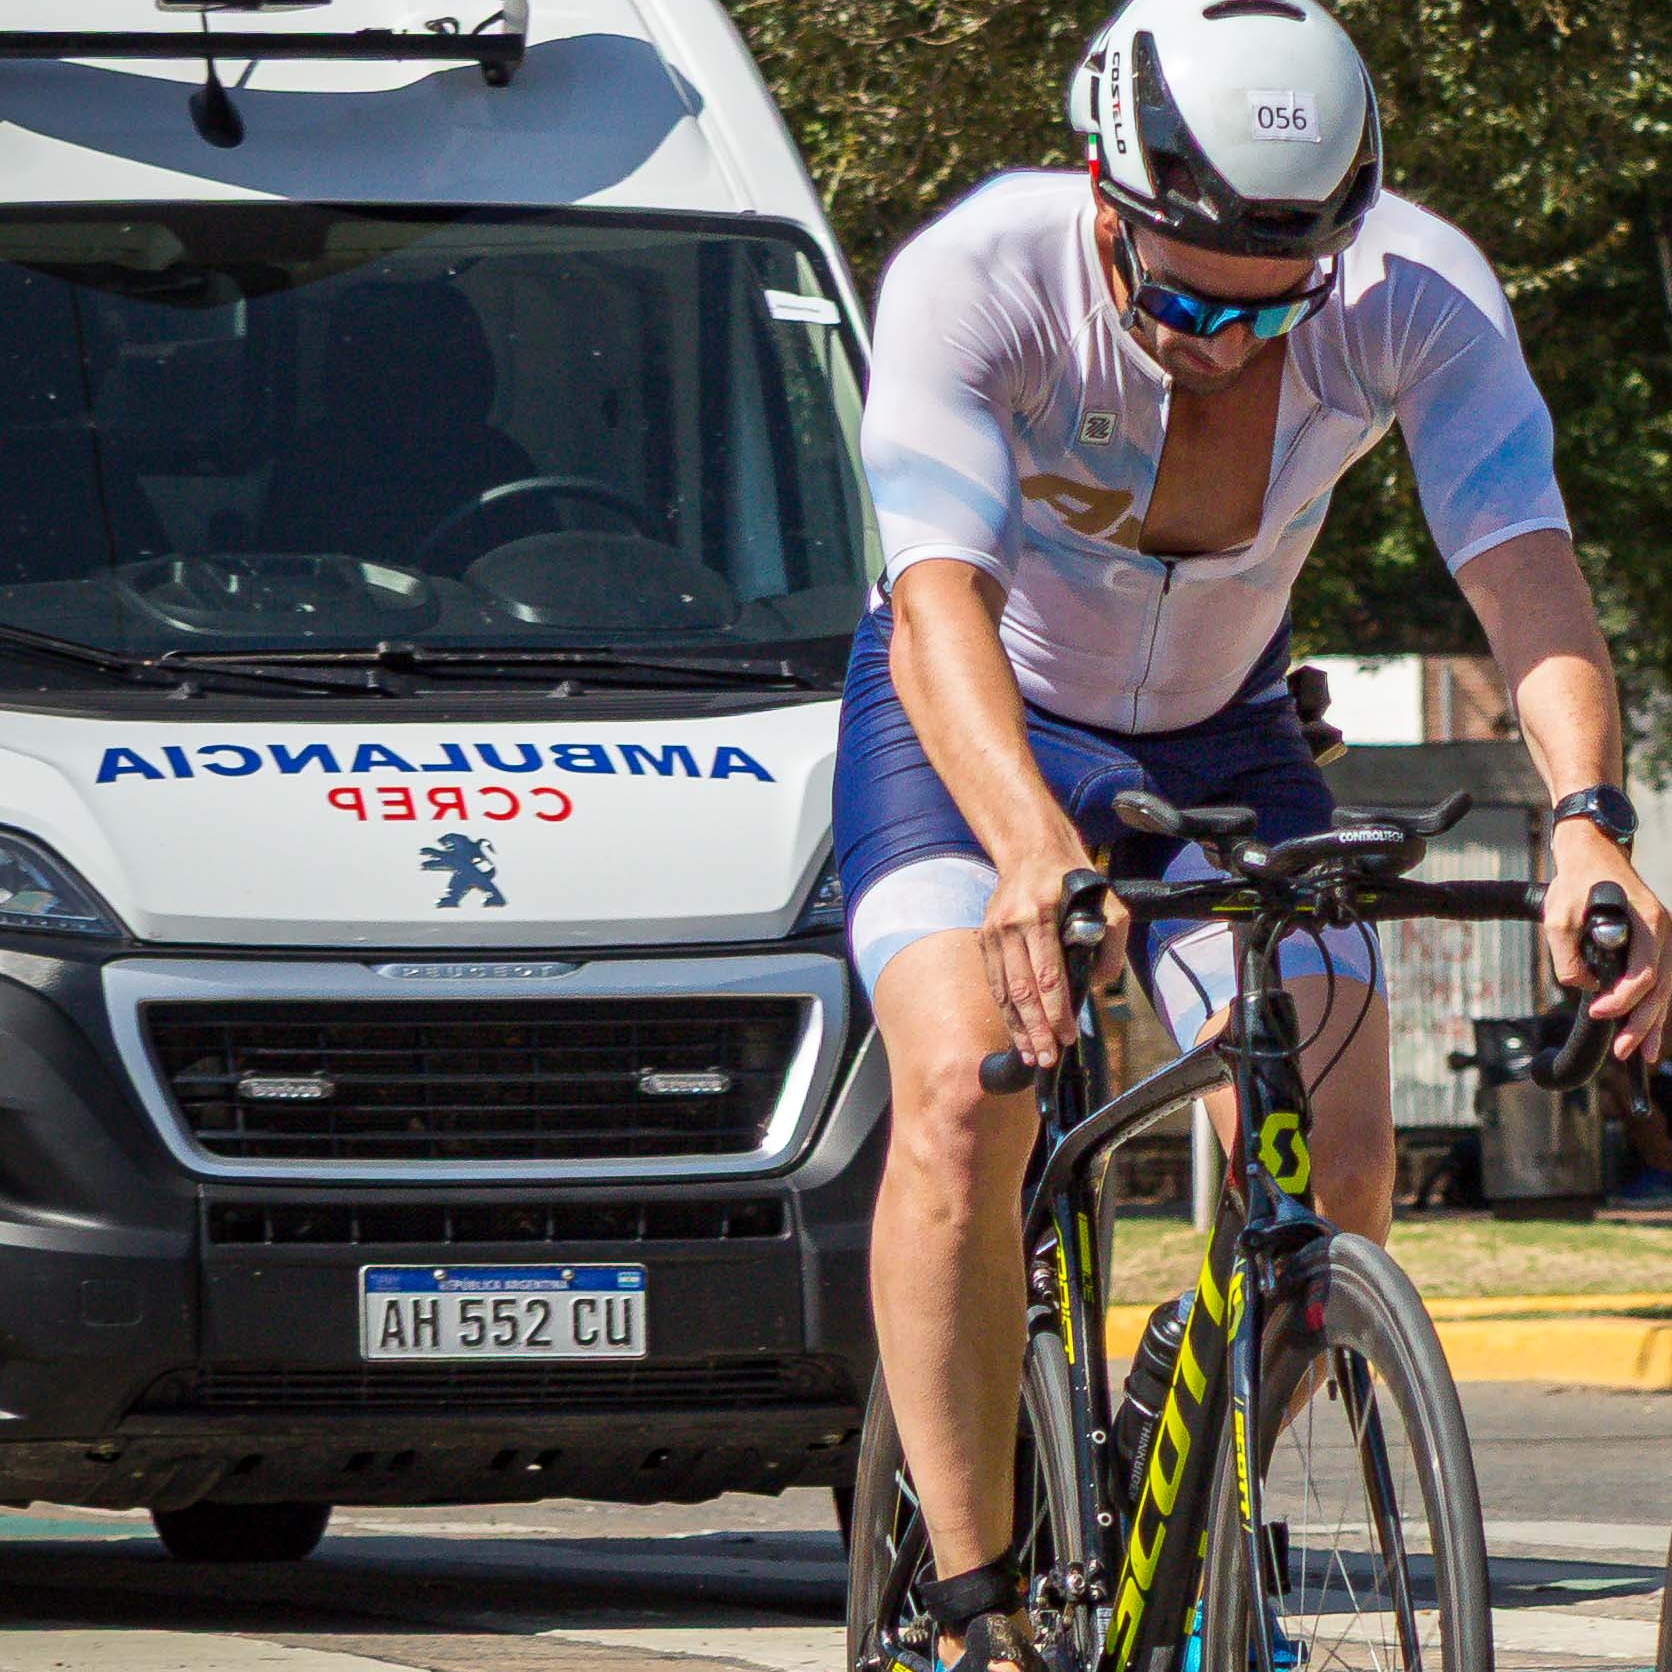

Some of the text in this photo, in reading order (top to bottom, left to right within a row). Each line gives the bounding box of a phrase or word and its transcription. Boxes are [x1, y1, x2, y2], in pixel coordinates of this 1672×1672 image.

[1111, 50, 1128, 155] COSTELO
[1257, 106, 1307, 130] 056
[1338, 829, 1405, 844] CONTROLTECH
[380, 1296, 632, 1350] AH 552 CU
[1233, 1408, 1251, 1521] SCOTT
